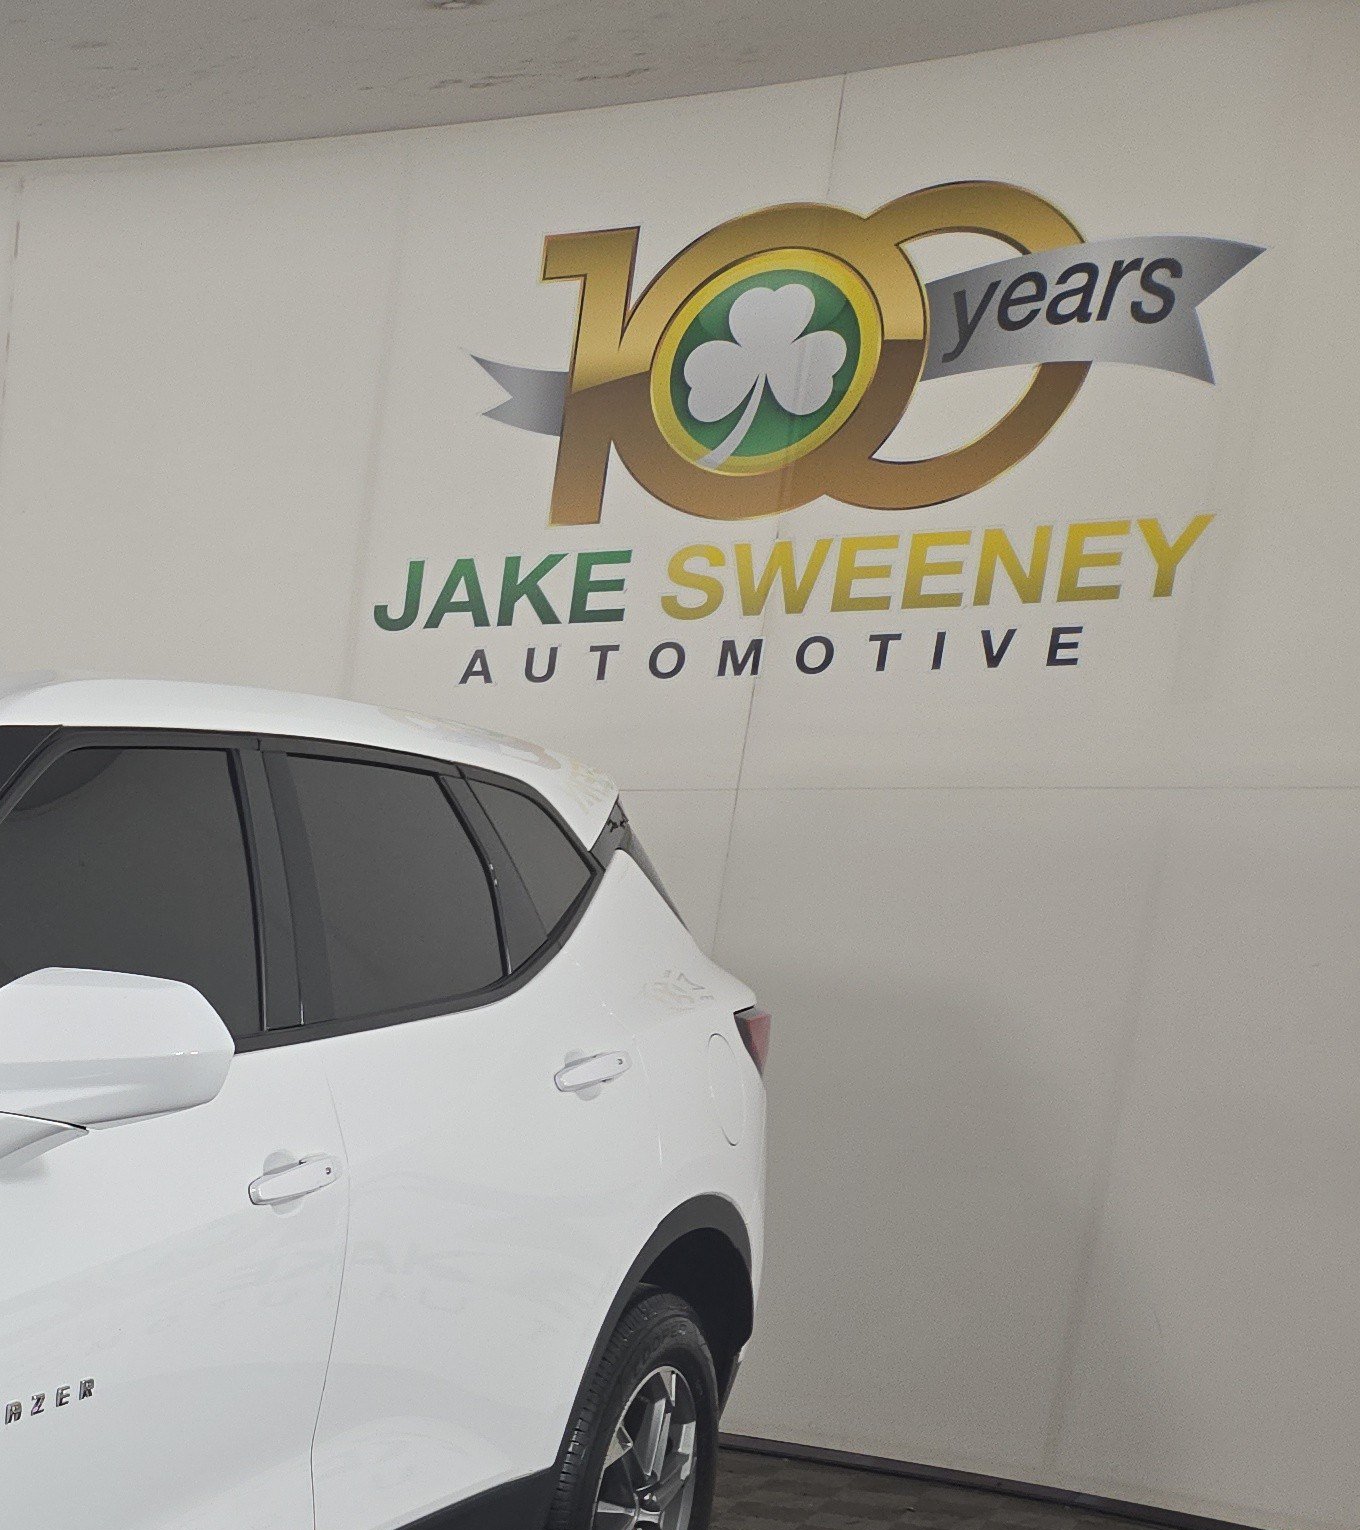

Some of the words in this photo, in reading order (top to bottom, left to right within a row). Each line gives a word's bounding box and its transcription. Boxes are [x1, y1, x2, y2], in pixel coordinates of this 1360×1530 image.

[941, 257, 1184, 363] years
[374, 549, 632, 632] JAKE
[660, 515, 1215, 621] SWEENEY
[459, 626, 1082, 685] AUTOMOTIVE
